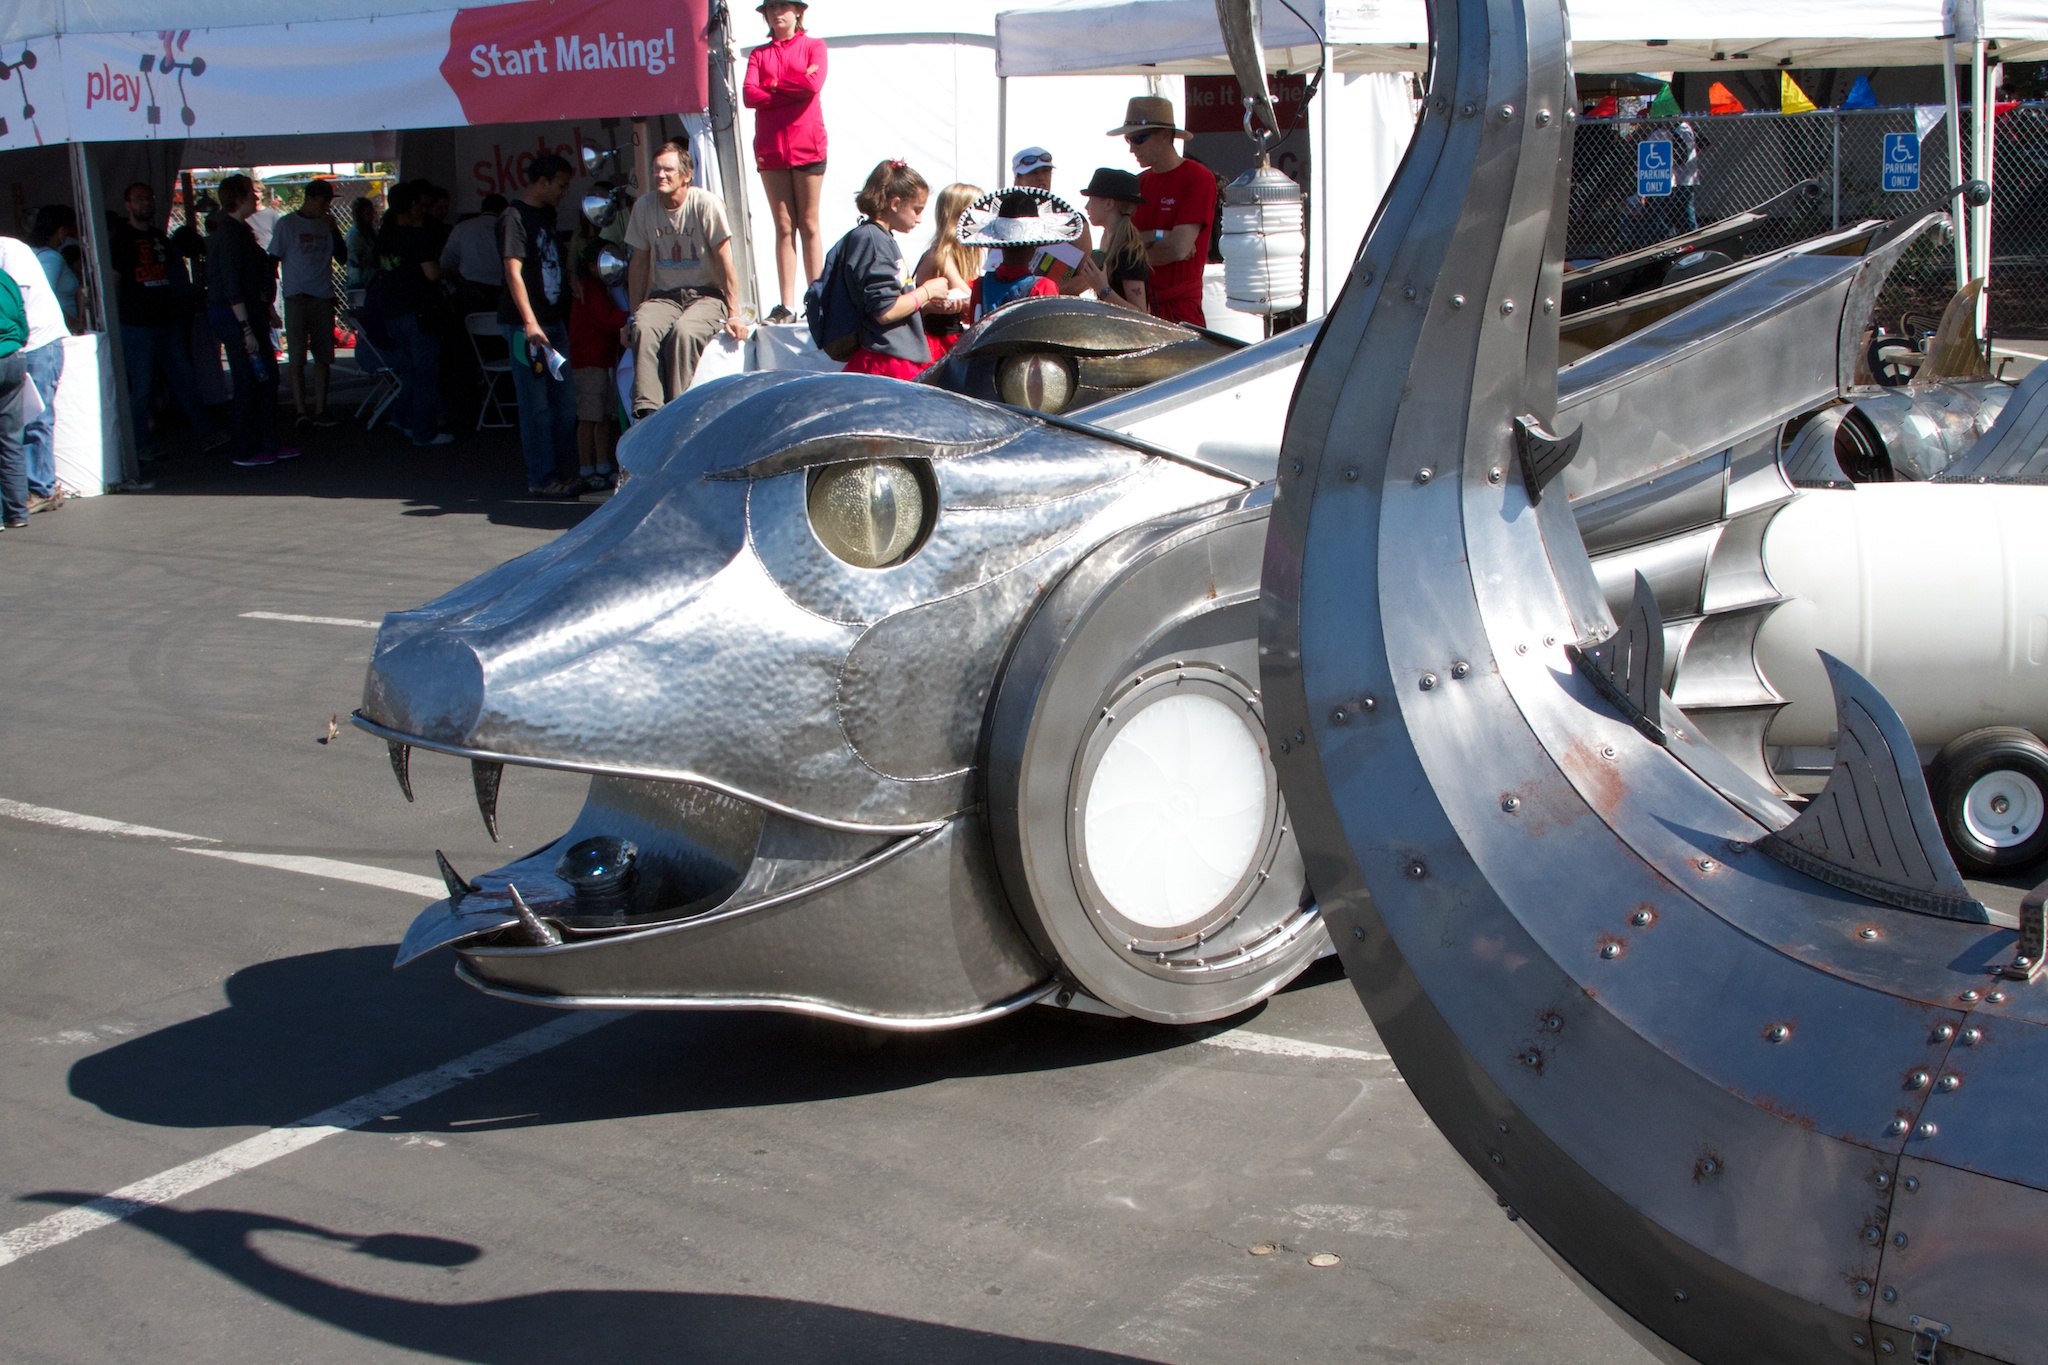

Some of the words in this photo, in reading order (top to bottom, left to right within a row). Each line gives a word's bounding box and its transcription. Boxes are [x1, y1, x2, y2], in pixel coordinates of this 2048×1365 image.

[469, 39, 548, 79] Start
[554, 28, 676, 75] Making!
[86, 63, 141, 112] play
[1186, 86, 1214, 107] ake
[1220, 85, 1235, 106] It
[1884, 162, 1918, 174] PARKING
[1640, 169, 1670, 180] PARKING
[1645, 181, 1664, 193] ONLY
[1891, 175, 1911, 187] ONLY
